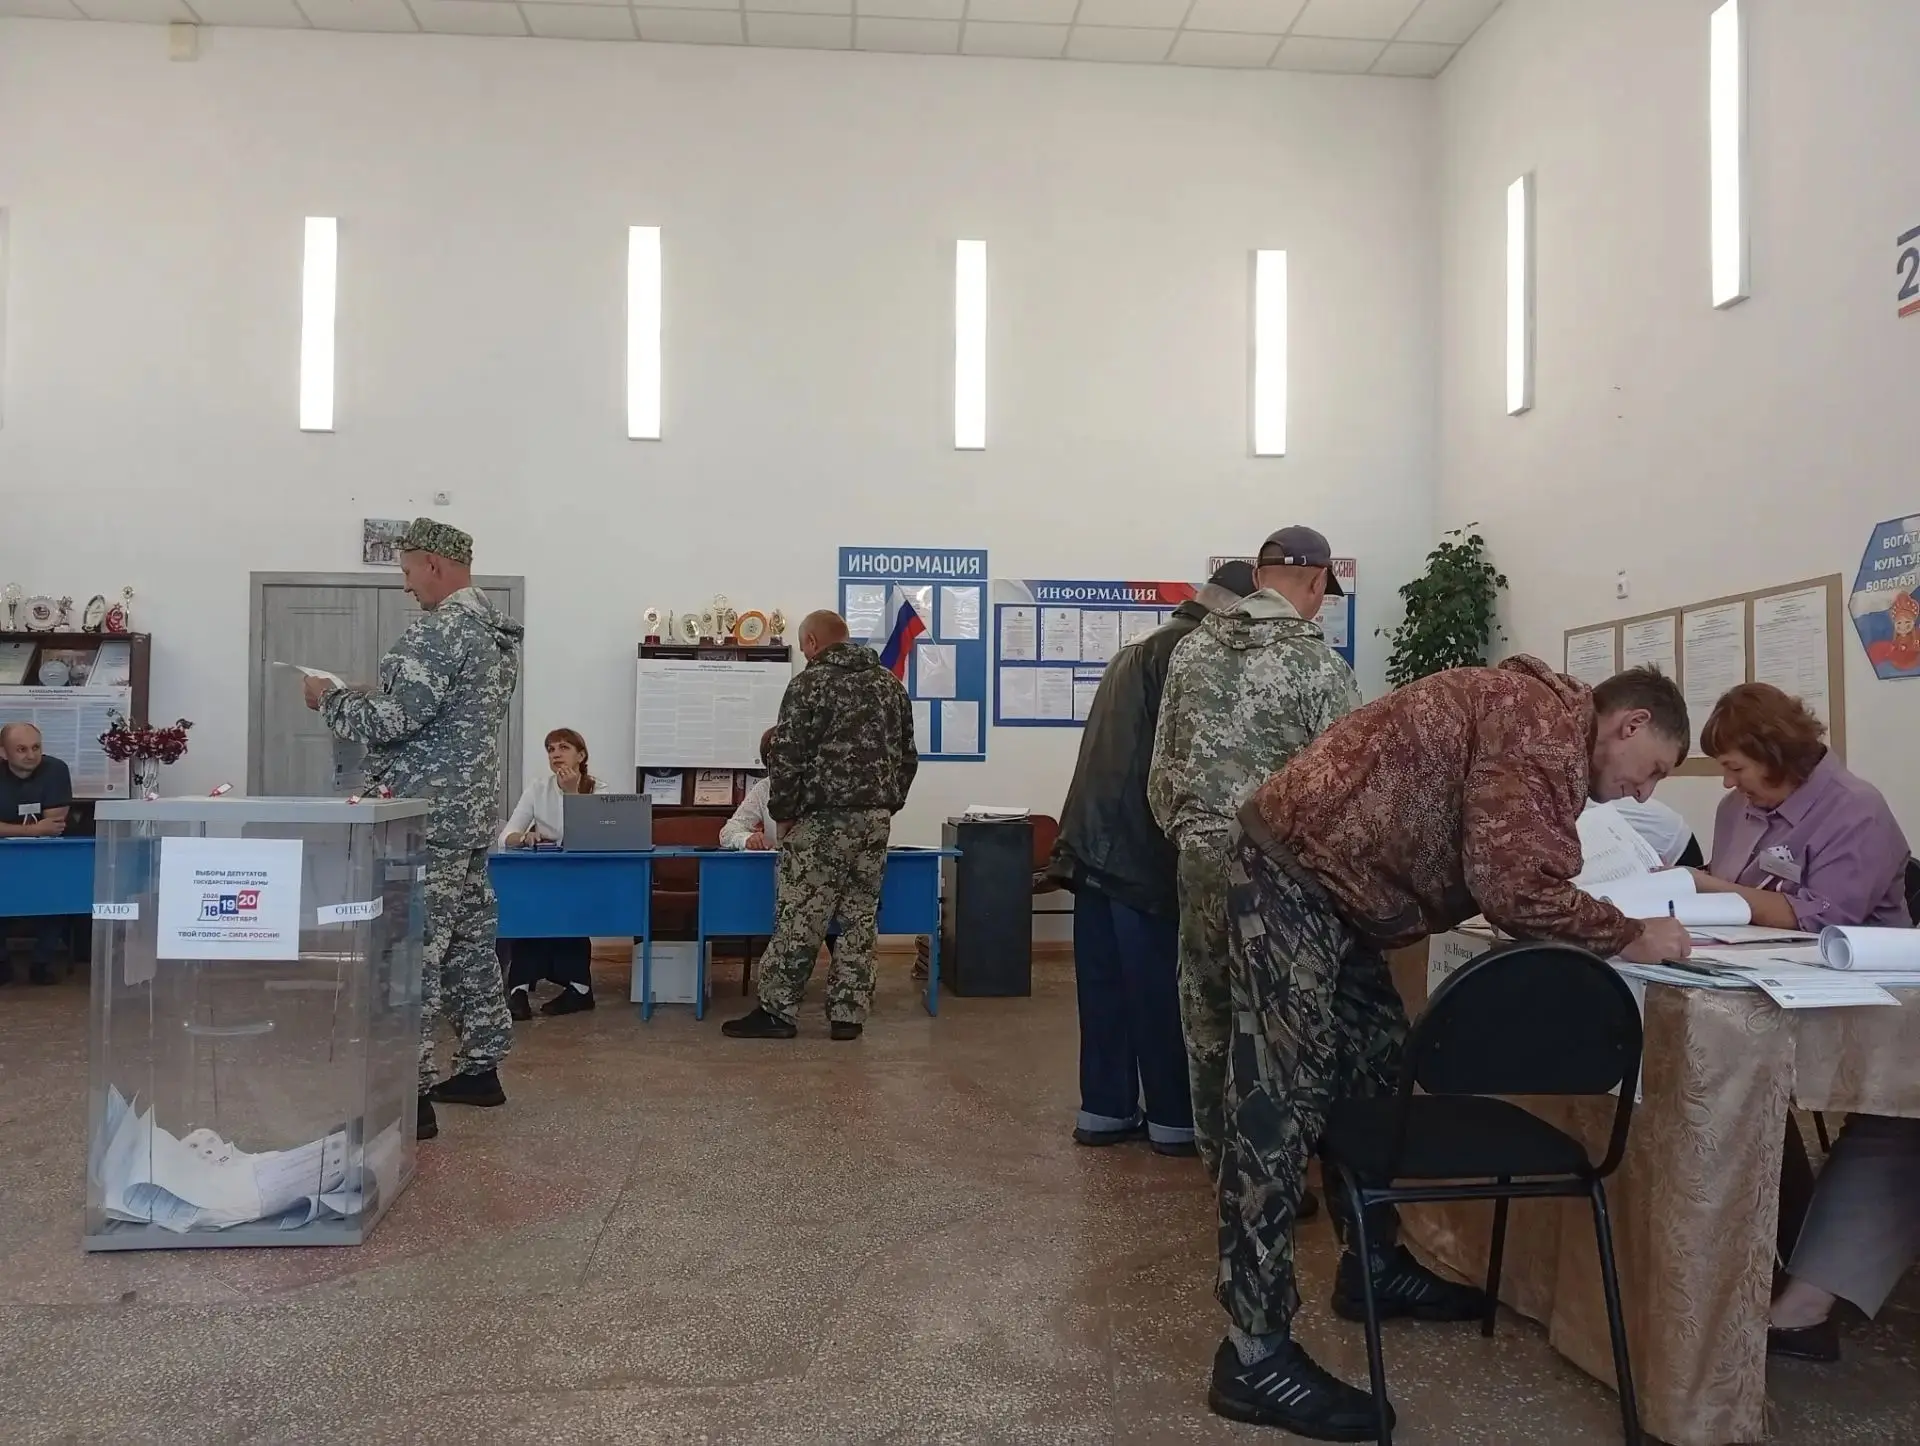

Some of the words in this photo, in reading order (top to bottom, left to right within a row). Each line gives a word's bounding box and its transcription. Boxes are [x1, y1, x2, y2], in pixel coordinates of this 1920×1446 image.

[848, 553, 980, 576] ИНФОРМАЦИЯ
[1037, 586, 1157, 602] ИНФОРМАЦИЯ
[1865, 574, 1916, 593] БОГАТАЯ
[204, 906, 218, 917] 18
[221, 899, 236, 911] 19
[239, 894, 256, 906] 20
